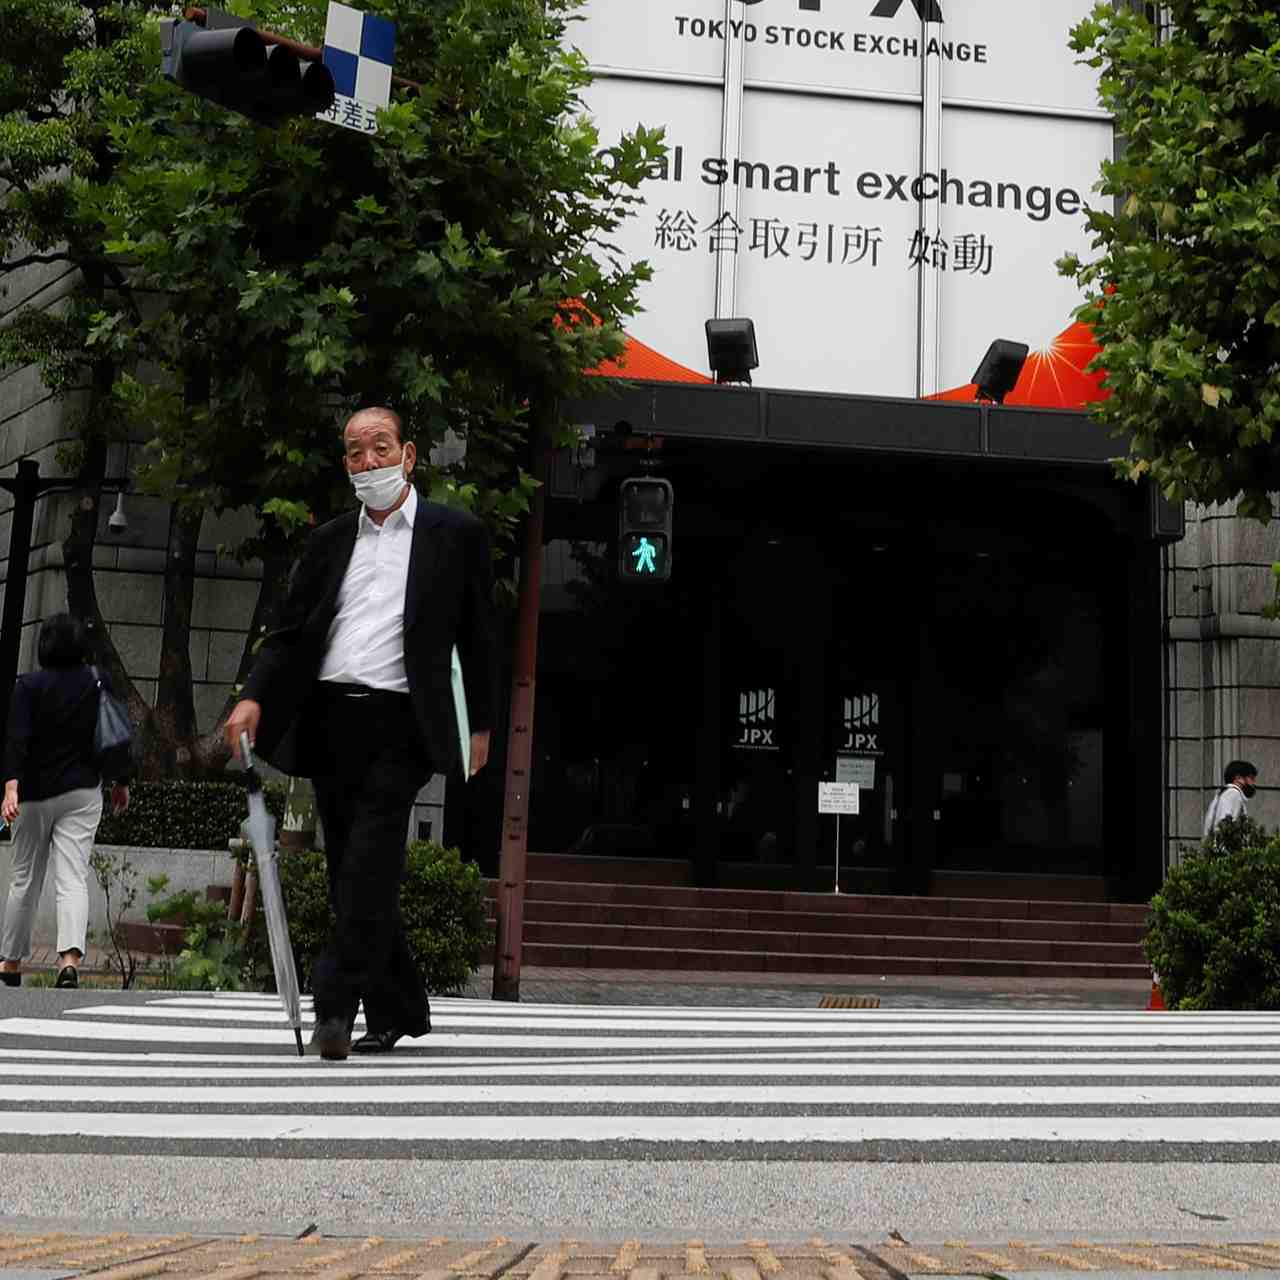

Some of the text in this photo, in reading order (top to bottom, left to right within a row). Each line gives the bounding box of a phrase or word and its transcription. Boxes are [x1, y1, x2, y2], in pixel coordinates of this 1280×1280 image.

[674, 16, 988, 64] TOKYO STOCK EXCHANGE
[700, 157, 841, 196] smart
[654, 208, 994, 276] 総合取引所 始動
[739, 728, 773, 745] JPX
[844, 733, 878, 749] JPX
